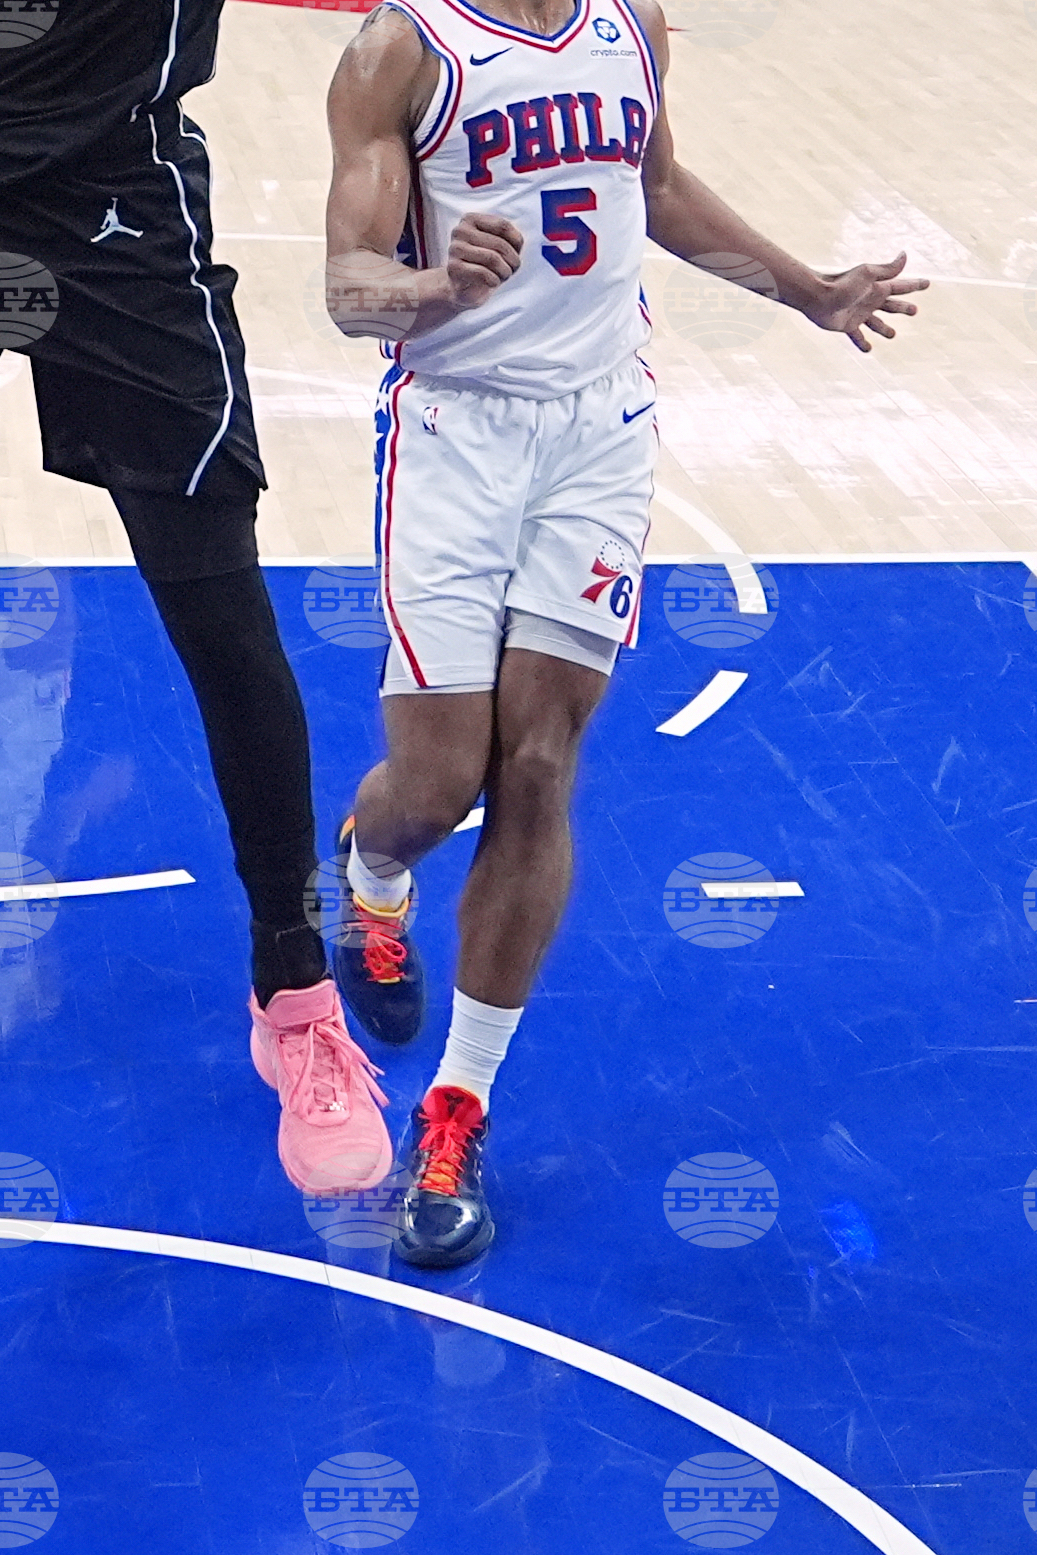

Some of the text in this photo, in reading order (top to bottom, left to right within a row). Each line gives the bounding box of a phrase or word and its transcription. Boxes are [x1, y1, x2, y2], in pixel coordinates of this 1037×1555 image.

[463, 92, 647, 188] PHILA
[541, 187, 598, 277] 5
[580, 556, 634, 619] 76
